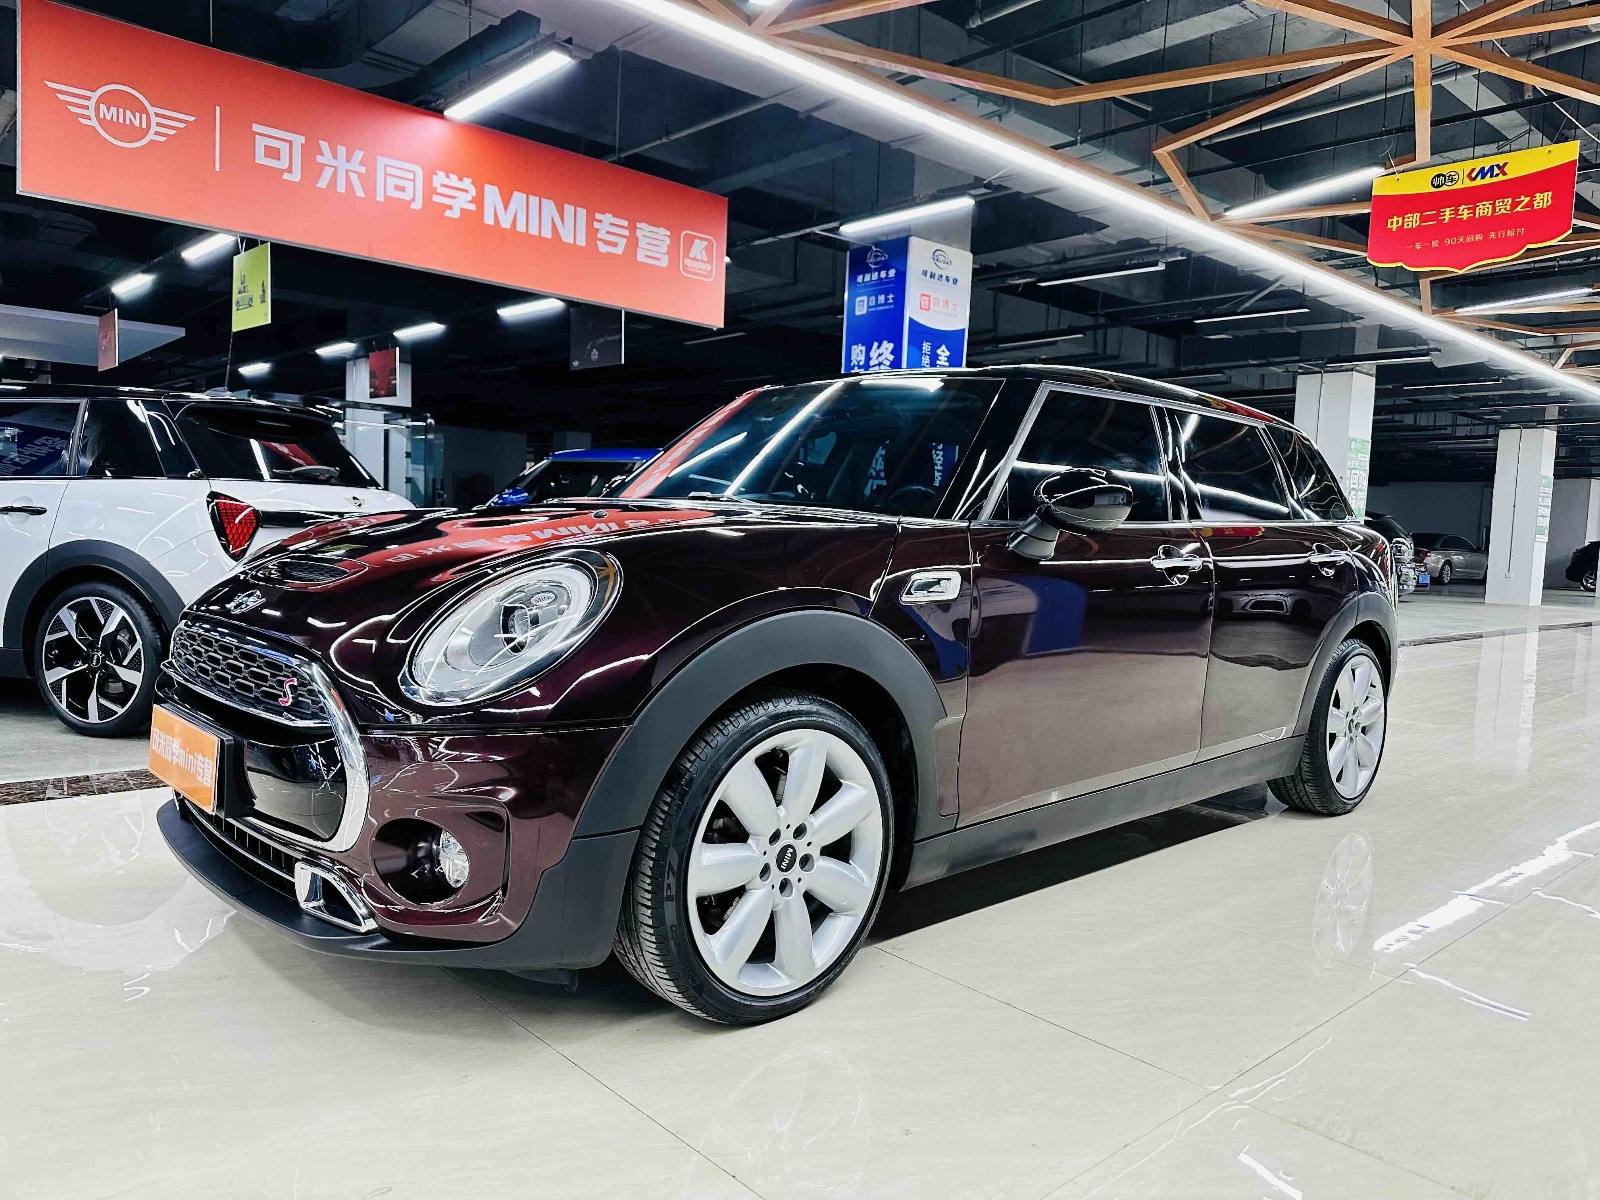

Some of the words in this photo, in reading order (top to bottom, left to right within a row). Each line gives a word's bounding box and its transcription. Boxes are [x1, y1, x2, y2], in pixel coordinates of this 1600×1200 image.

[99, 103, 147, 129] MINI
[251, 122, 671, 268] 可米同学MINI专营
[1387, 191, 1552, 231] 中部二手车商贸之都
[869, 340, 895, 369] 终
[936, 343, 951, 367] 全
[780, 847, 794, 870] MINI
